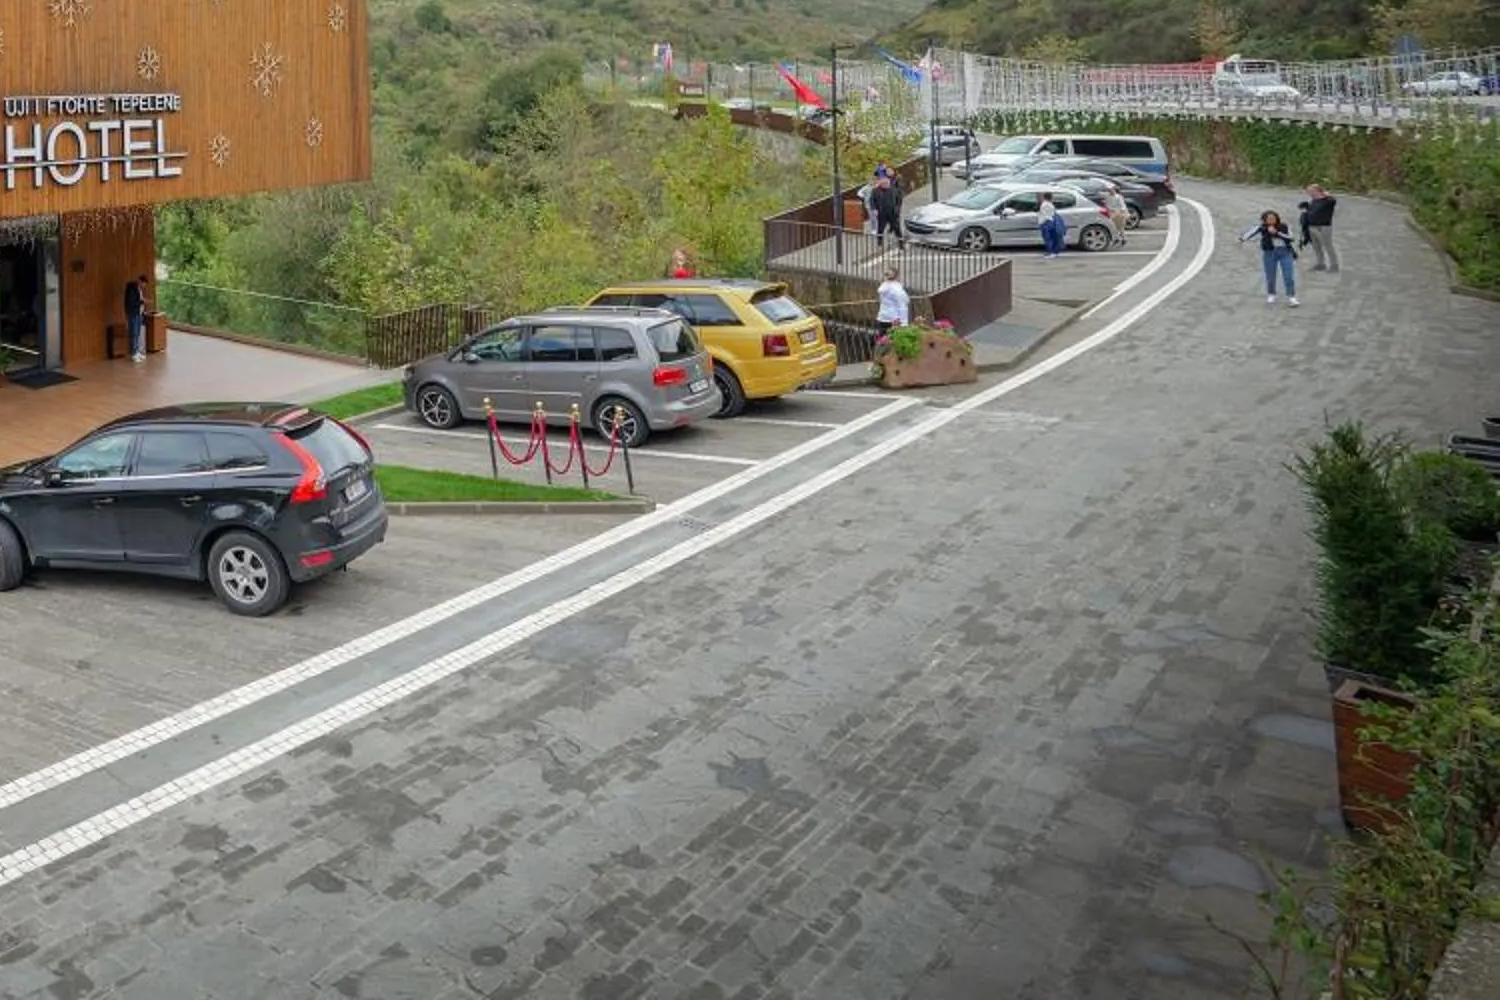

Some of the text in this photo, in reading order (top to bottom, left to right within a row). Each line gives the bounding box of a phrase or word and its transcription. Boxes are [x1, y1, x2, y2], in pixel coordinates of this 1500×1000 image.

[5, 97, 29, 116] UJI
[48, 96, 106, 114] FTOHTE
[5, 119, 183, 189] HOTEL
